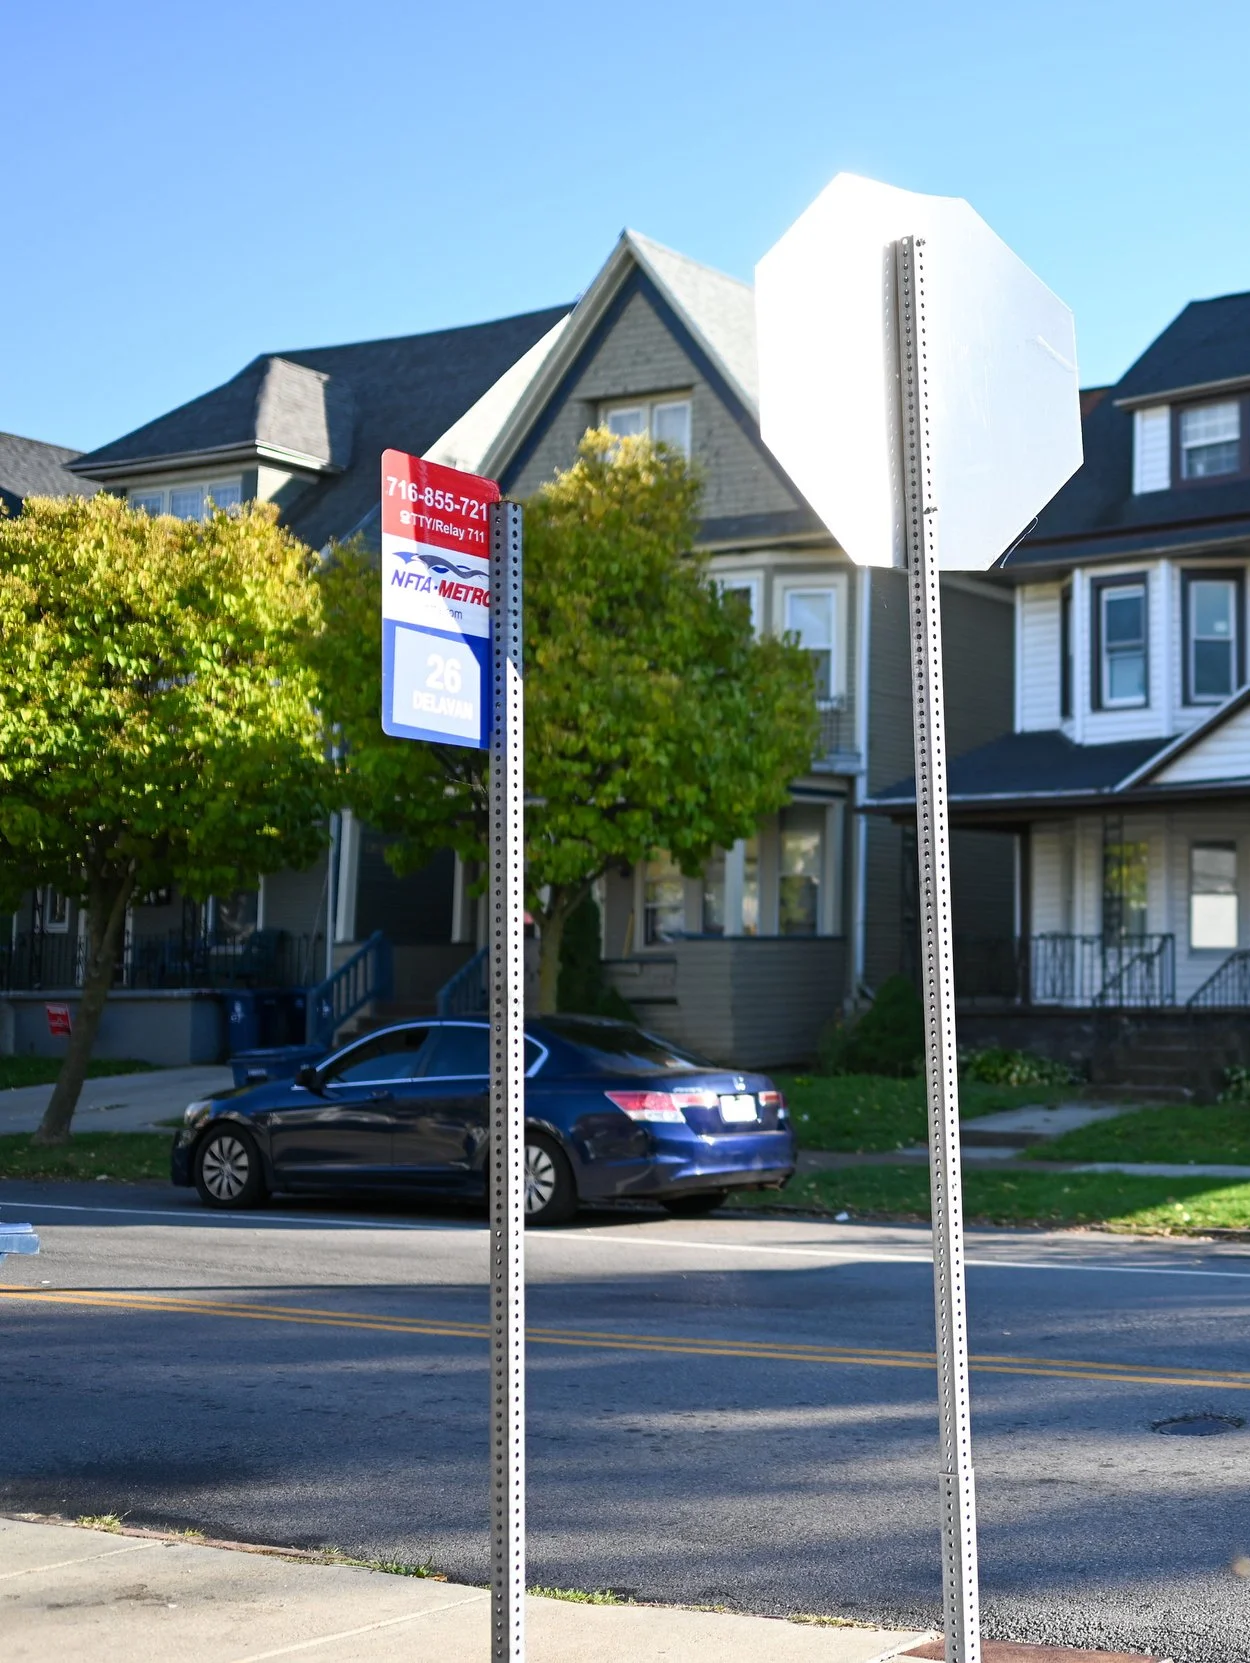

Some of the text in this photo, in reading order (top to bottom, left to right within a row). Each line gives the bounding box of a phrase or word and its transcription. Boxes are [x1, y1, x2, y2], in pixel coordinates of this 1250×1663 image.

[386, 476, 489, 522] 716-855-721
[410, 512, 485, 544] TTY/Relay 711
[425, 653, 462, 694] 26
[412, 689, 474, 721] DELAVAN
